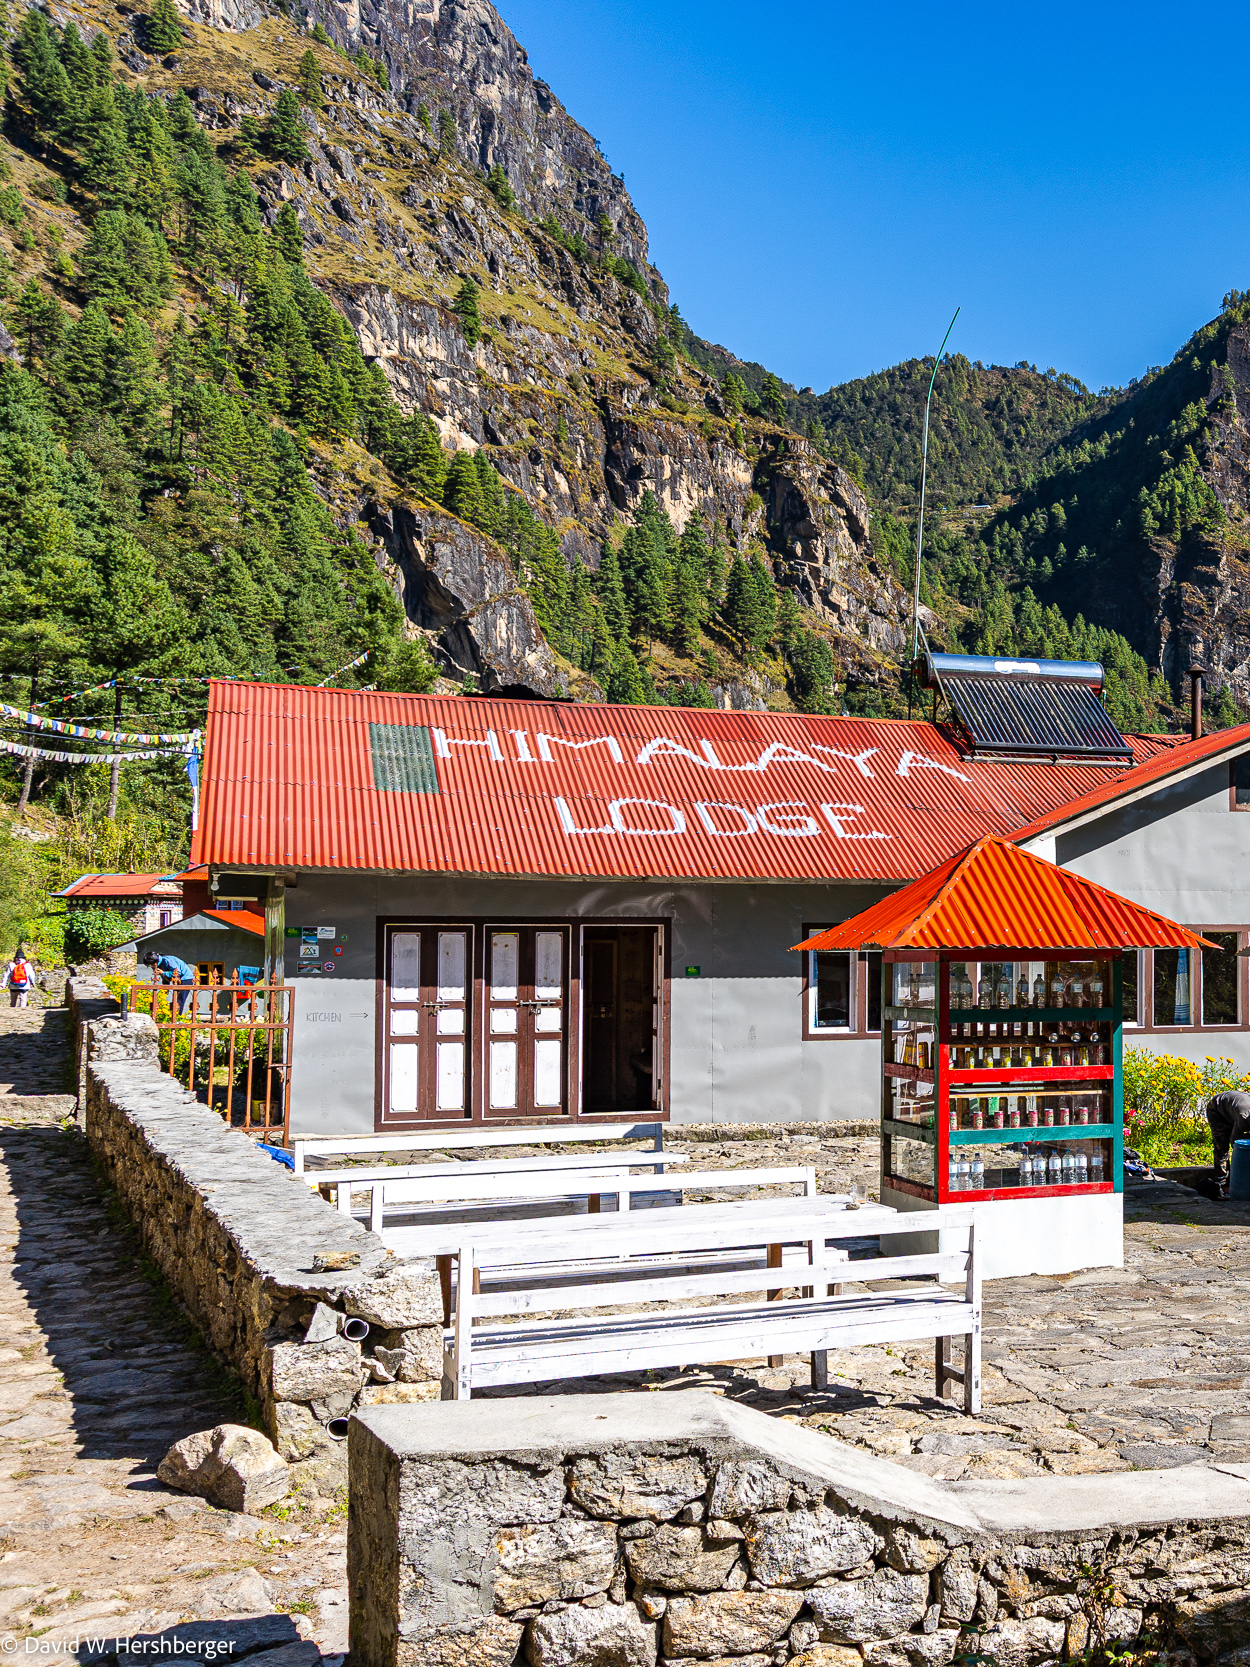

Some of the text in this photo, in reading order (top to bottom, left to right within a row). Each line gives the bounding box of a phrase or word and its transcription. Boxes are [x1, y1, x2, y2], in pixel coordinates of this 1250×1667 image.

[432, 727, 972, 782] HIMALAYA
[554, 796, 890, 841] LODGE
[306, 1012, 342, 1022] KITCHEN
